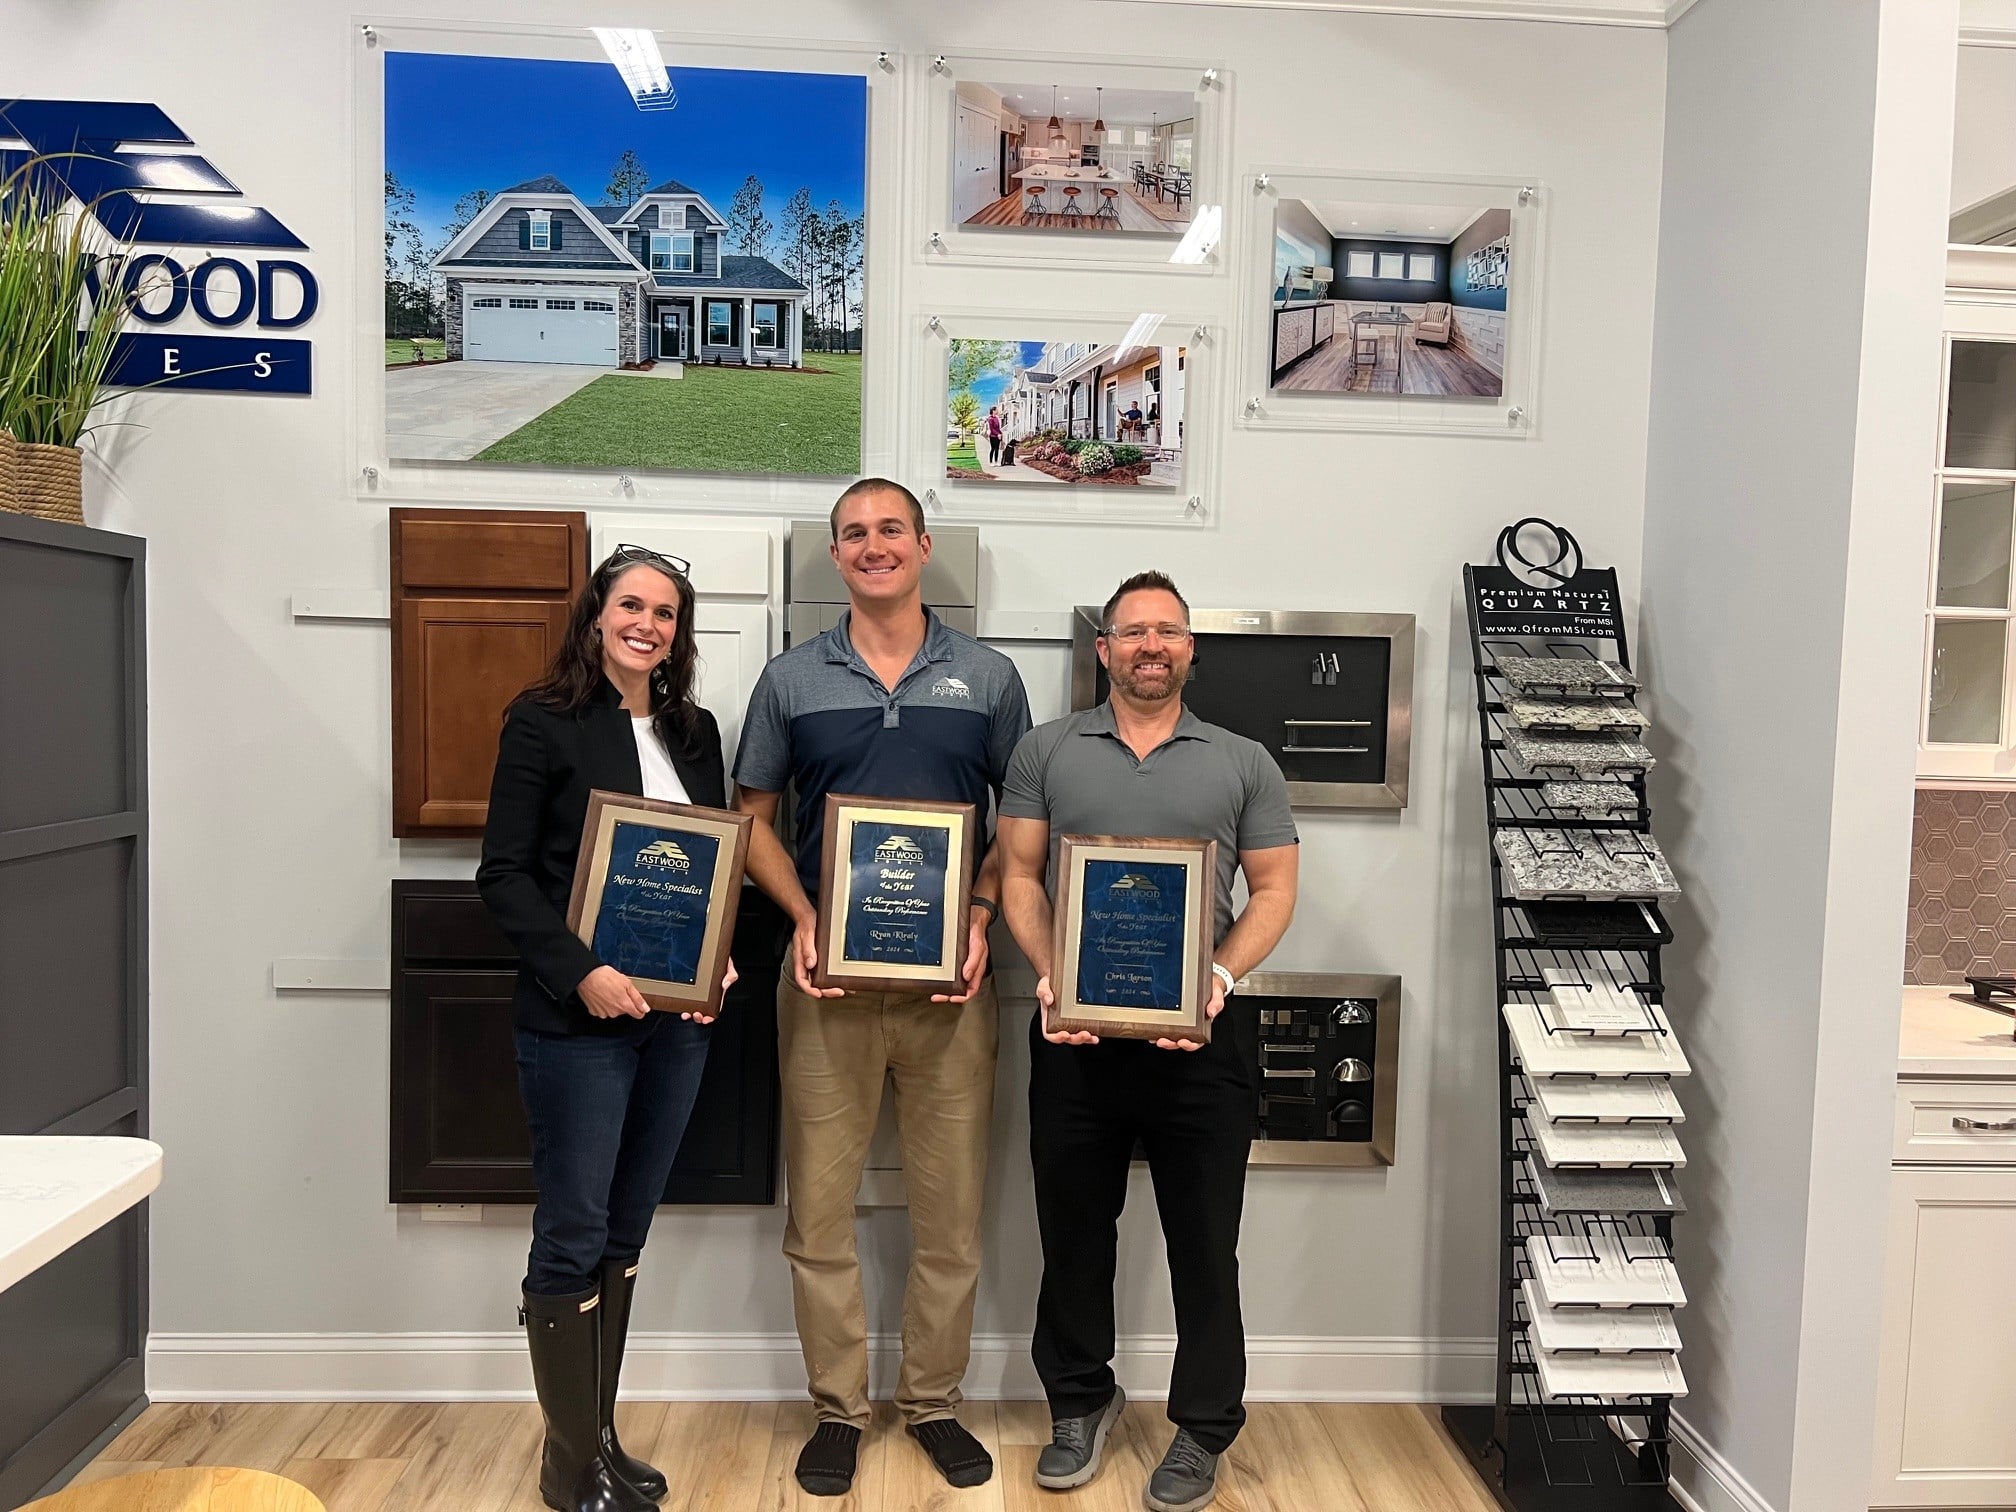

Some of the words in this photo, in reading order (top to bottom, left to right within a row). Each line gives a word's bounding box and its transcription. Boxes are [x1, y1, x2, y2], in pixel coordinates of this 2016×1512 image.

[1480, 588, 1546, 597] Premium
[1482, 598, 1612, 612] QUARTZ
[1574, 617, 1596, 625] From
[1597, 618, 1614, 626] MSI
[1485, 624, 1616, 637] www.QfromMSI.com
[932, 685, 970, 695] EASTWOOD
[875, 850, 923, 859] EASTWOOD
[636, 853, 690, 868] EASTWOOD
[880, 868, 915, 880] Builder
[613, 874, 636, 887] New
[635, 877, 661, 890] Home
[661, 881, 704, 896] Specialist
[892, 881, 915, 892] Year
[651, 891, 673, 901] Year
[1109, 889, 1160, 898] EASTWOOD
[1090, 910, 1111, 920] New
[1112, 911, 1136, 921] Home
[1136, 912, 1176, 923] Specialist
[1128, 923, 1148, 931] Year
[869, 929, 891, 940] Ryan
[1105, 971, 1126, 981] Chris
